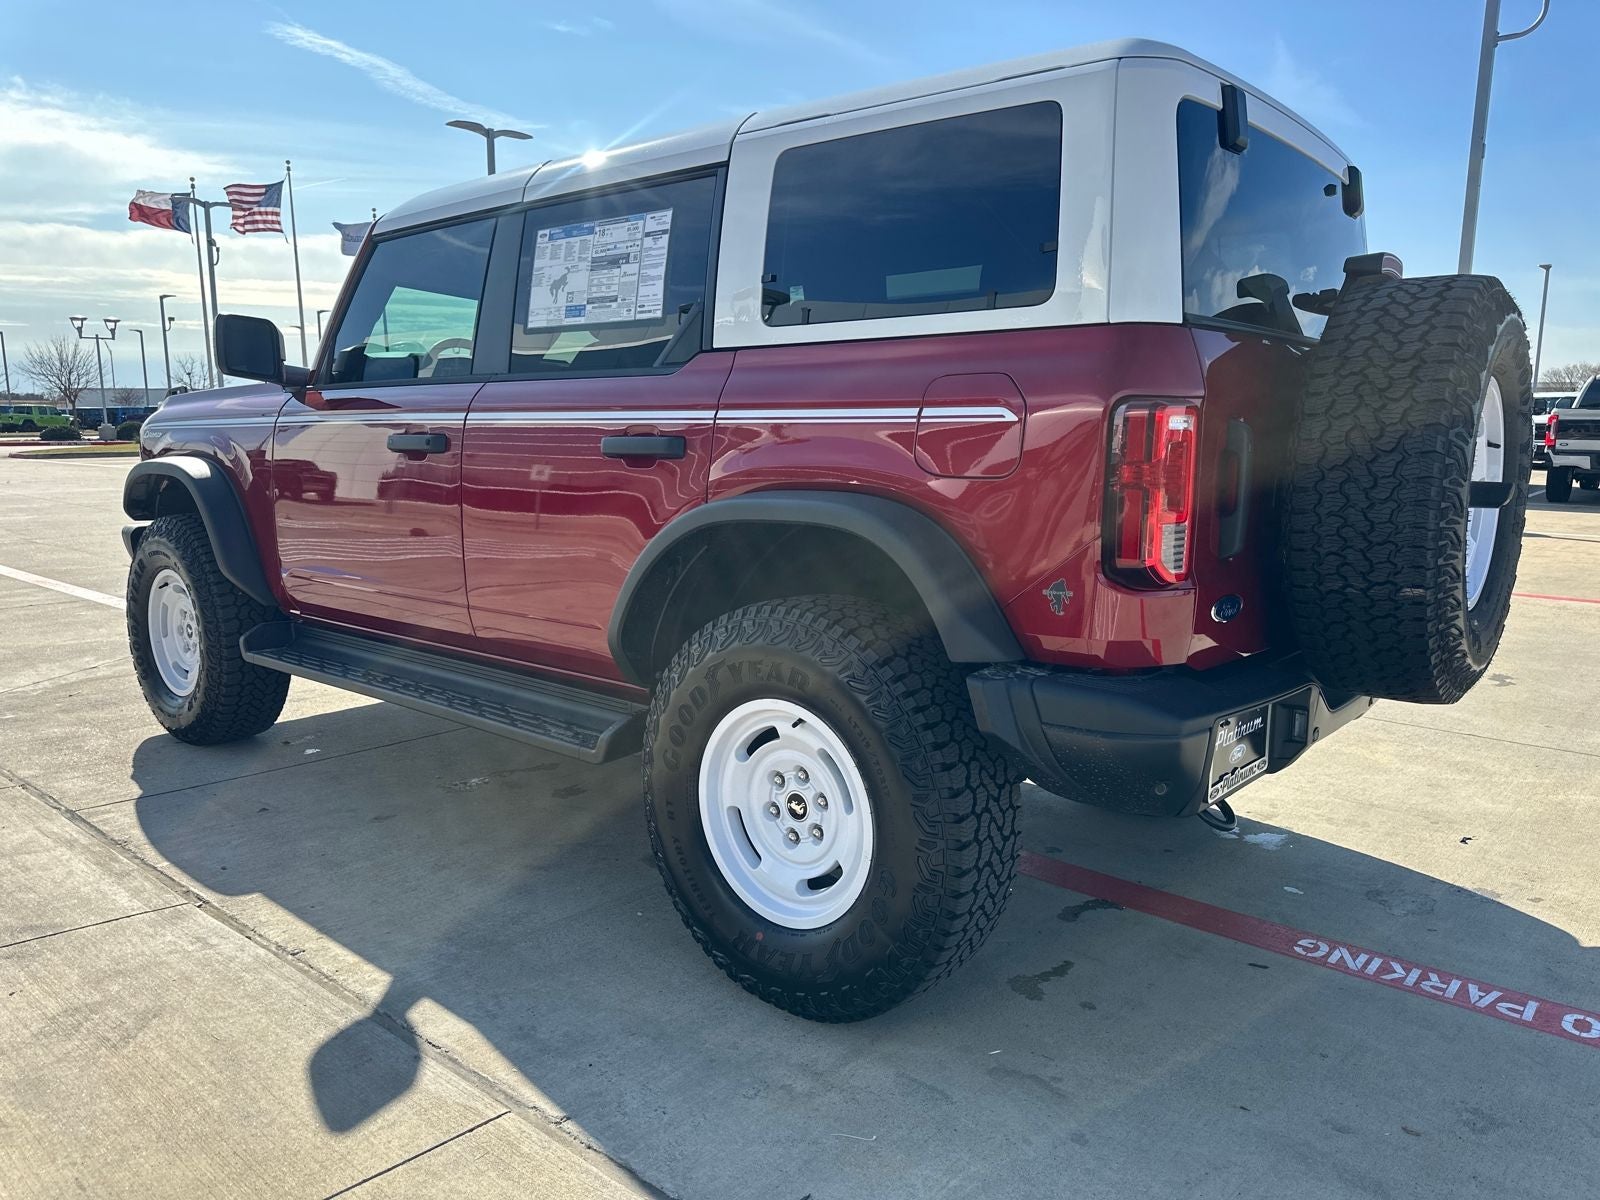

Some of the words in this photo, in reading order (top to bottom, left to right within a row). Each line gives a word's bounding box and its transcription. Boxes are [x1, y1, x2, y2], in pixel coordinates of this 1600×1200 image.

[663, 658, 811, 773] GOODYEAR
[1215, 716, 1264, 751] Platinum
[1221, 767, 1257, 793] Platinum
[1293, 938, 1541, 1022] PARKING
